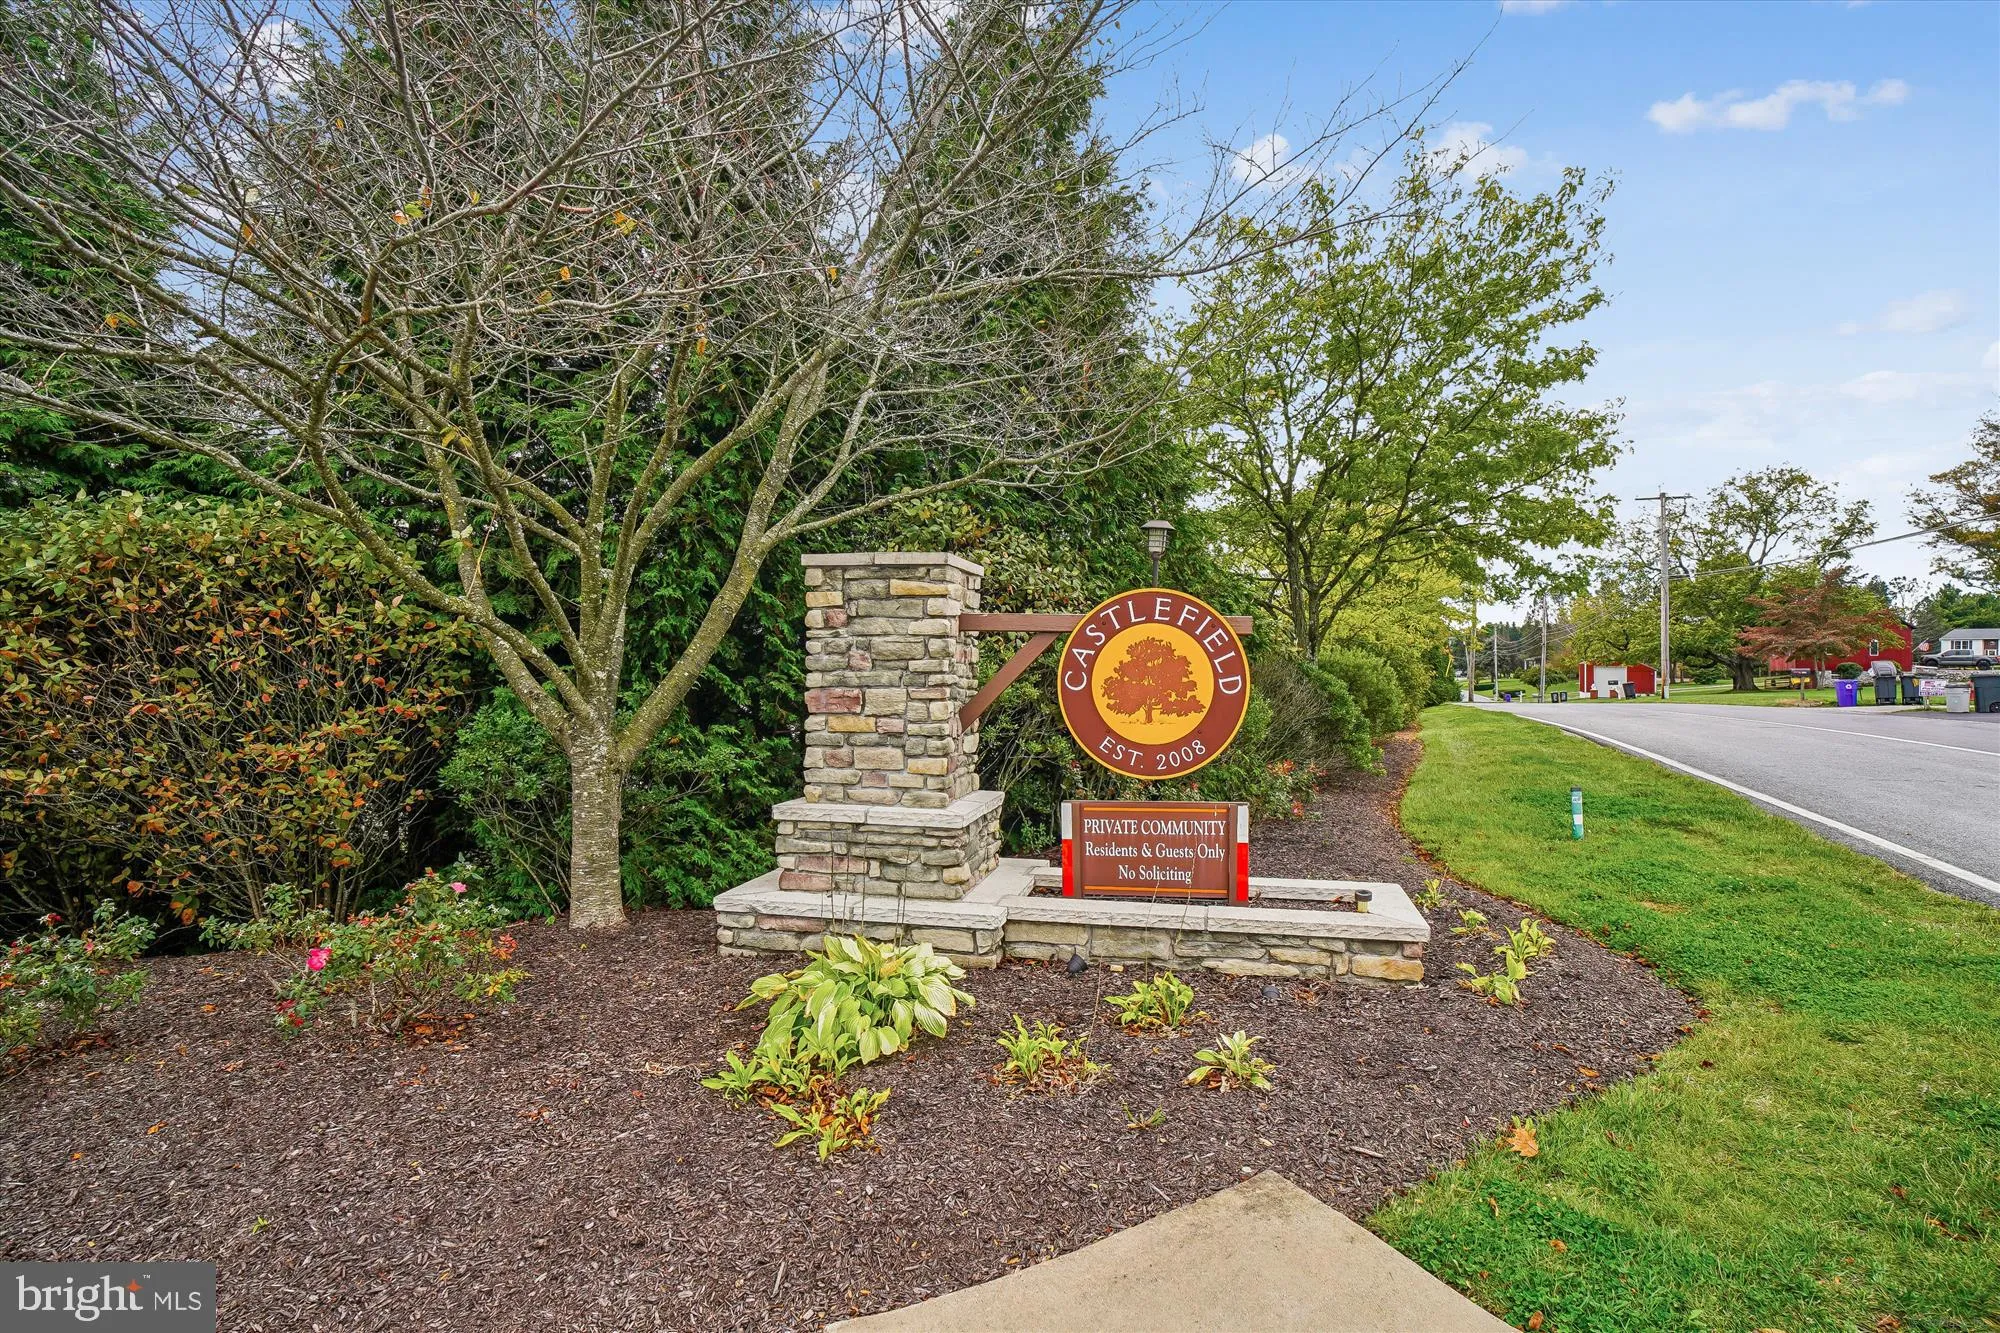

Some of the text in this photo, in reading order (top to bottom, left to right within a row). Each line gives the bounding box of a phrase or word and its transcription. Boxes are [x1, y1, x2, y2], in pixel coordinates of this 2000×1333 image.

[1065, 598, 1242, 695] CASTLEFIELD
[1099, 736, 1206, 770] EST. 2008
[1083, 818, 1226, 836] PRIVATE COMMUNITY
[1085, 841, 1225, 862] Residents & Guests Only
[1118, 864, 1192, 884] No Soliciting
